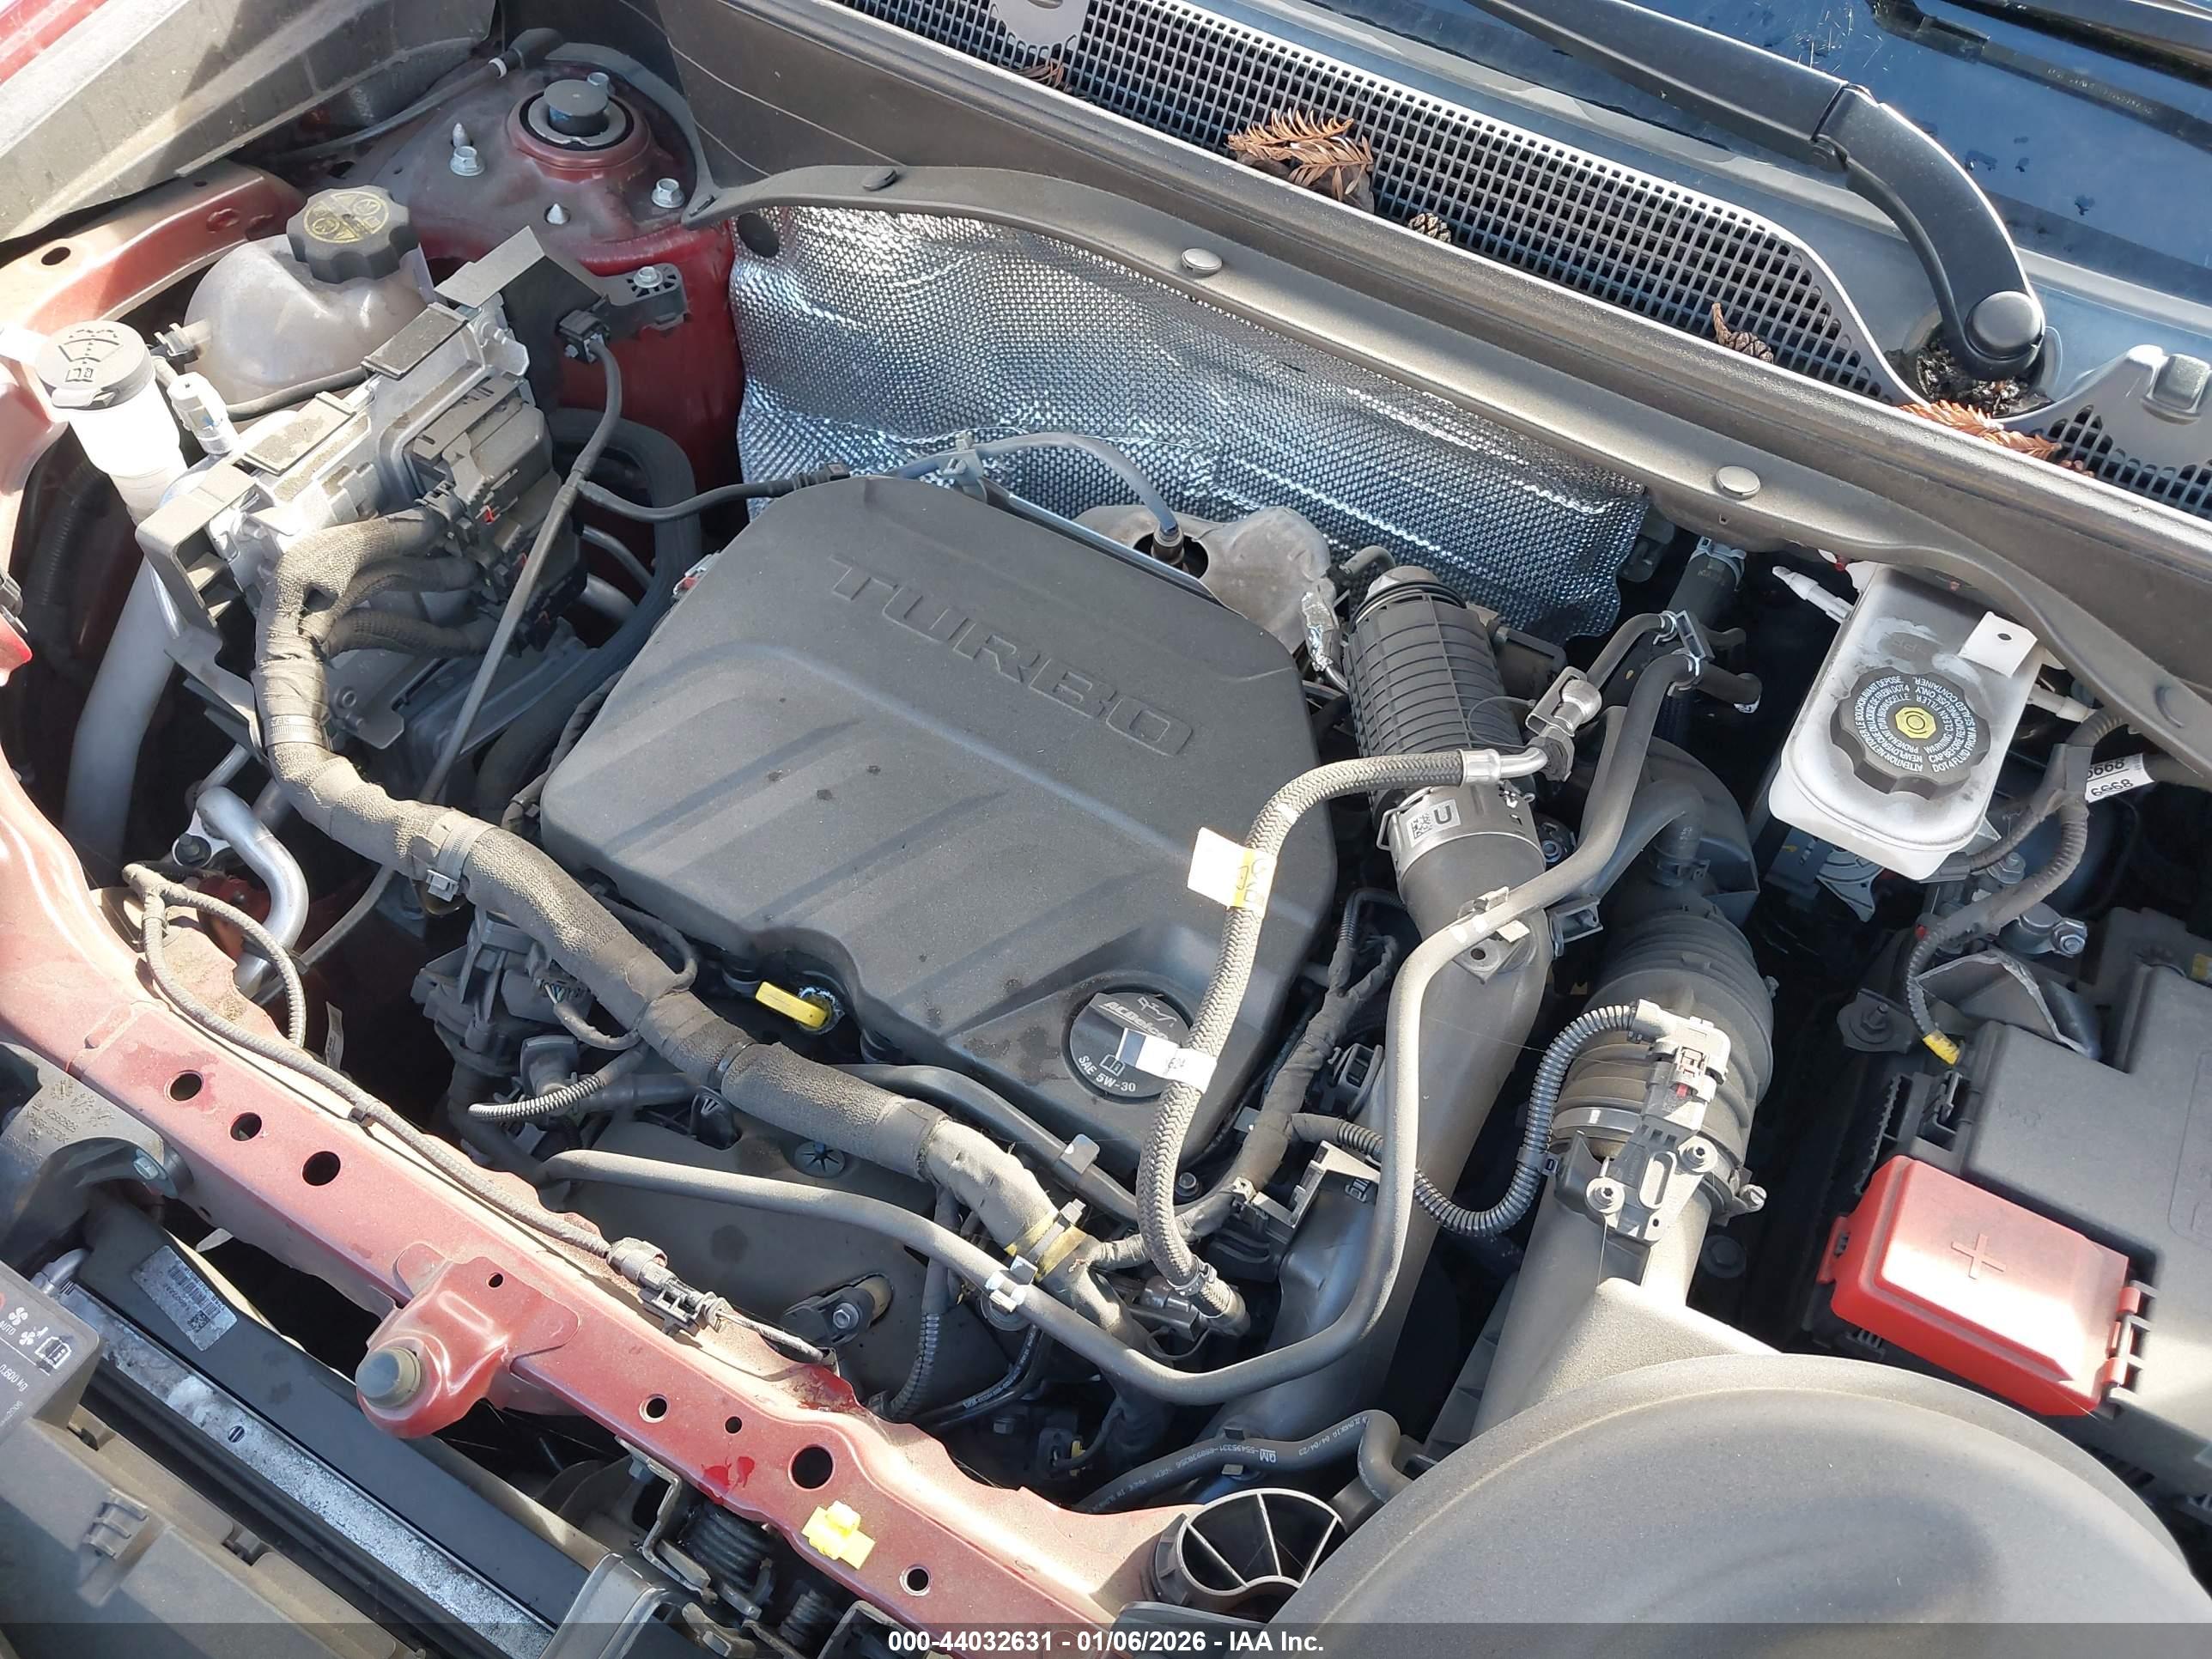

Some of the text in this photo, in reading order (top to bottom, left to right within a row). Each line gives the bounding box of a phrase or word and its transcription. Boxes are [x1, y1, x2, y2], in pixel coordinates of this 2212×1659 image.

[830, 555, 1194, 757] TURBO
[1915, 686, 1936, 698] ONLY
[1855, 696, 1867, 720] BOUCHON
[1917, 695, 1941, 711] FILLER
[1936, 695, 1950, 708] USE
[1939, 709, 1954, 732] CLEAN
[1954, 701, 1976, 726] SEALED
[1855, 720, 1865, 729] LE
[1942, 738, 1964, 758] BEFORE
[1965, 732, 1977, 751] FROM
[1929, 753, 1944, 763] CAP
[1952, 749, 1971, 765] FLUID
[1433, 805, 1452, 824] U
[1079, 1055, 1136, 1092] SAE 5W-30
[17, 1378, 28, 1392] kg
[1259, 1449, 1277, 1463] GM
